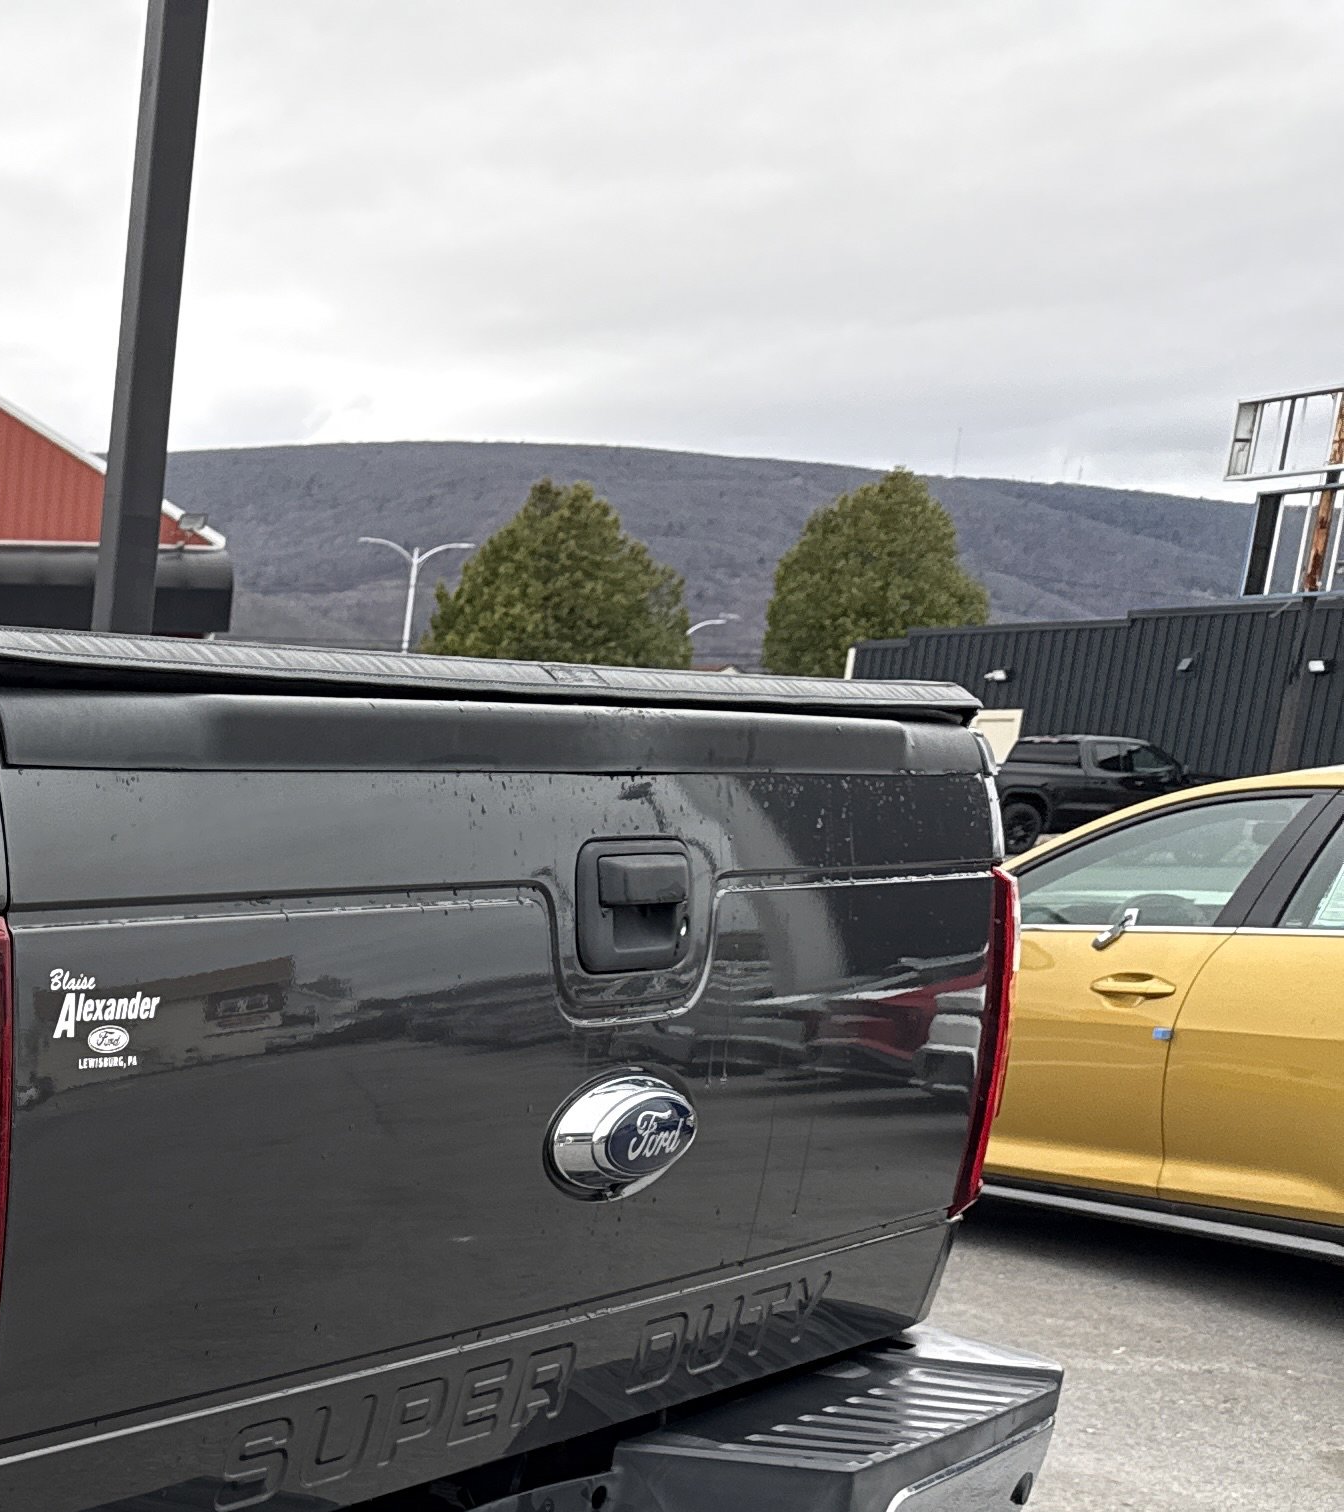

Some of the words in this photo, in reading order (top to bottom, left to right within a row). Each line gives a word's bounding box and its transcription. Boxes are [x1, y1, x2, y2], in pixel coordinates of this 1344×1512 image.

[50, 968, 96, 990] Blaise
[53, 991, 161, 1038] Alexander
[78, 1056, 127, 1069] LEWISBURG,
[128, 1056, 138, 1066] PA
[628, 1109, 685, 1161] Ford
[214, 1342, 578, 1512] SUPER
[625, 1270, 832, 1396] DUTY
